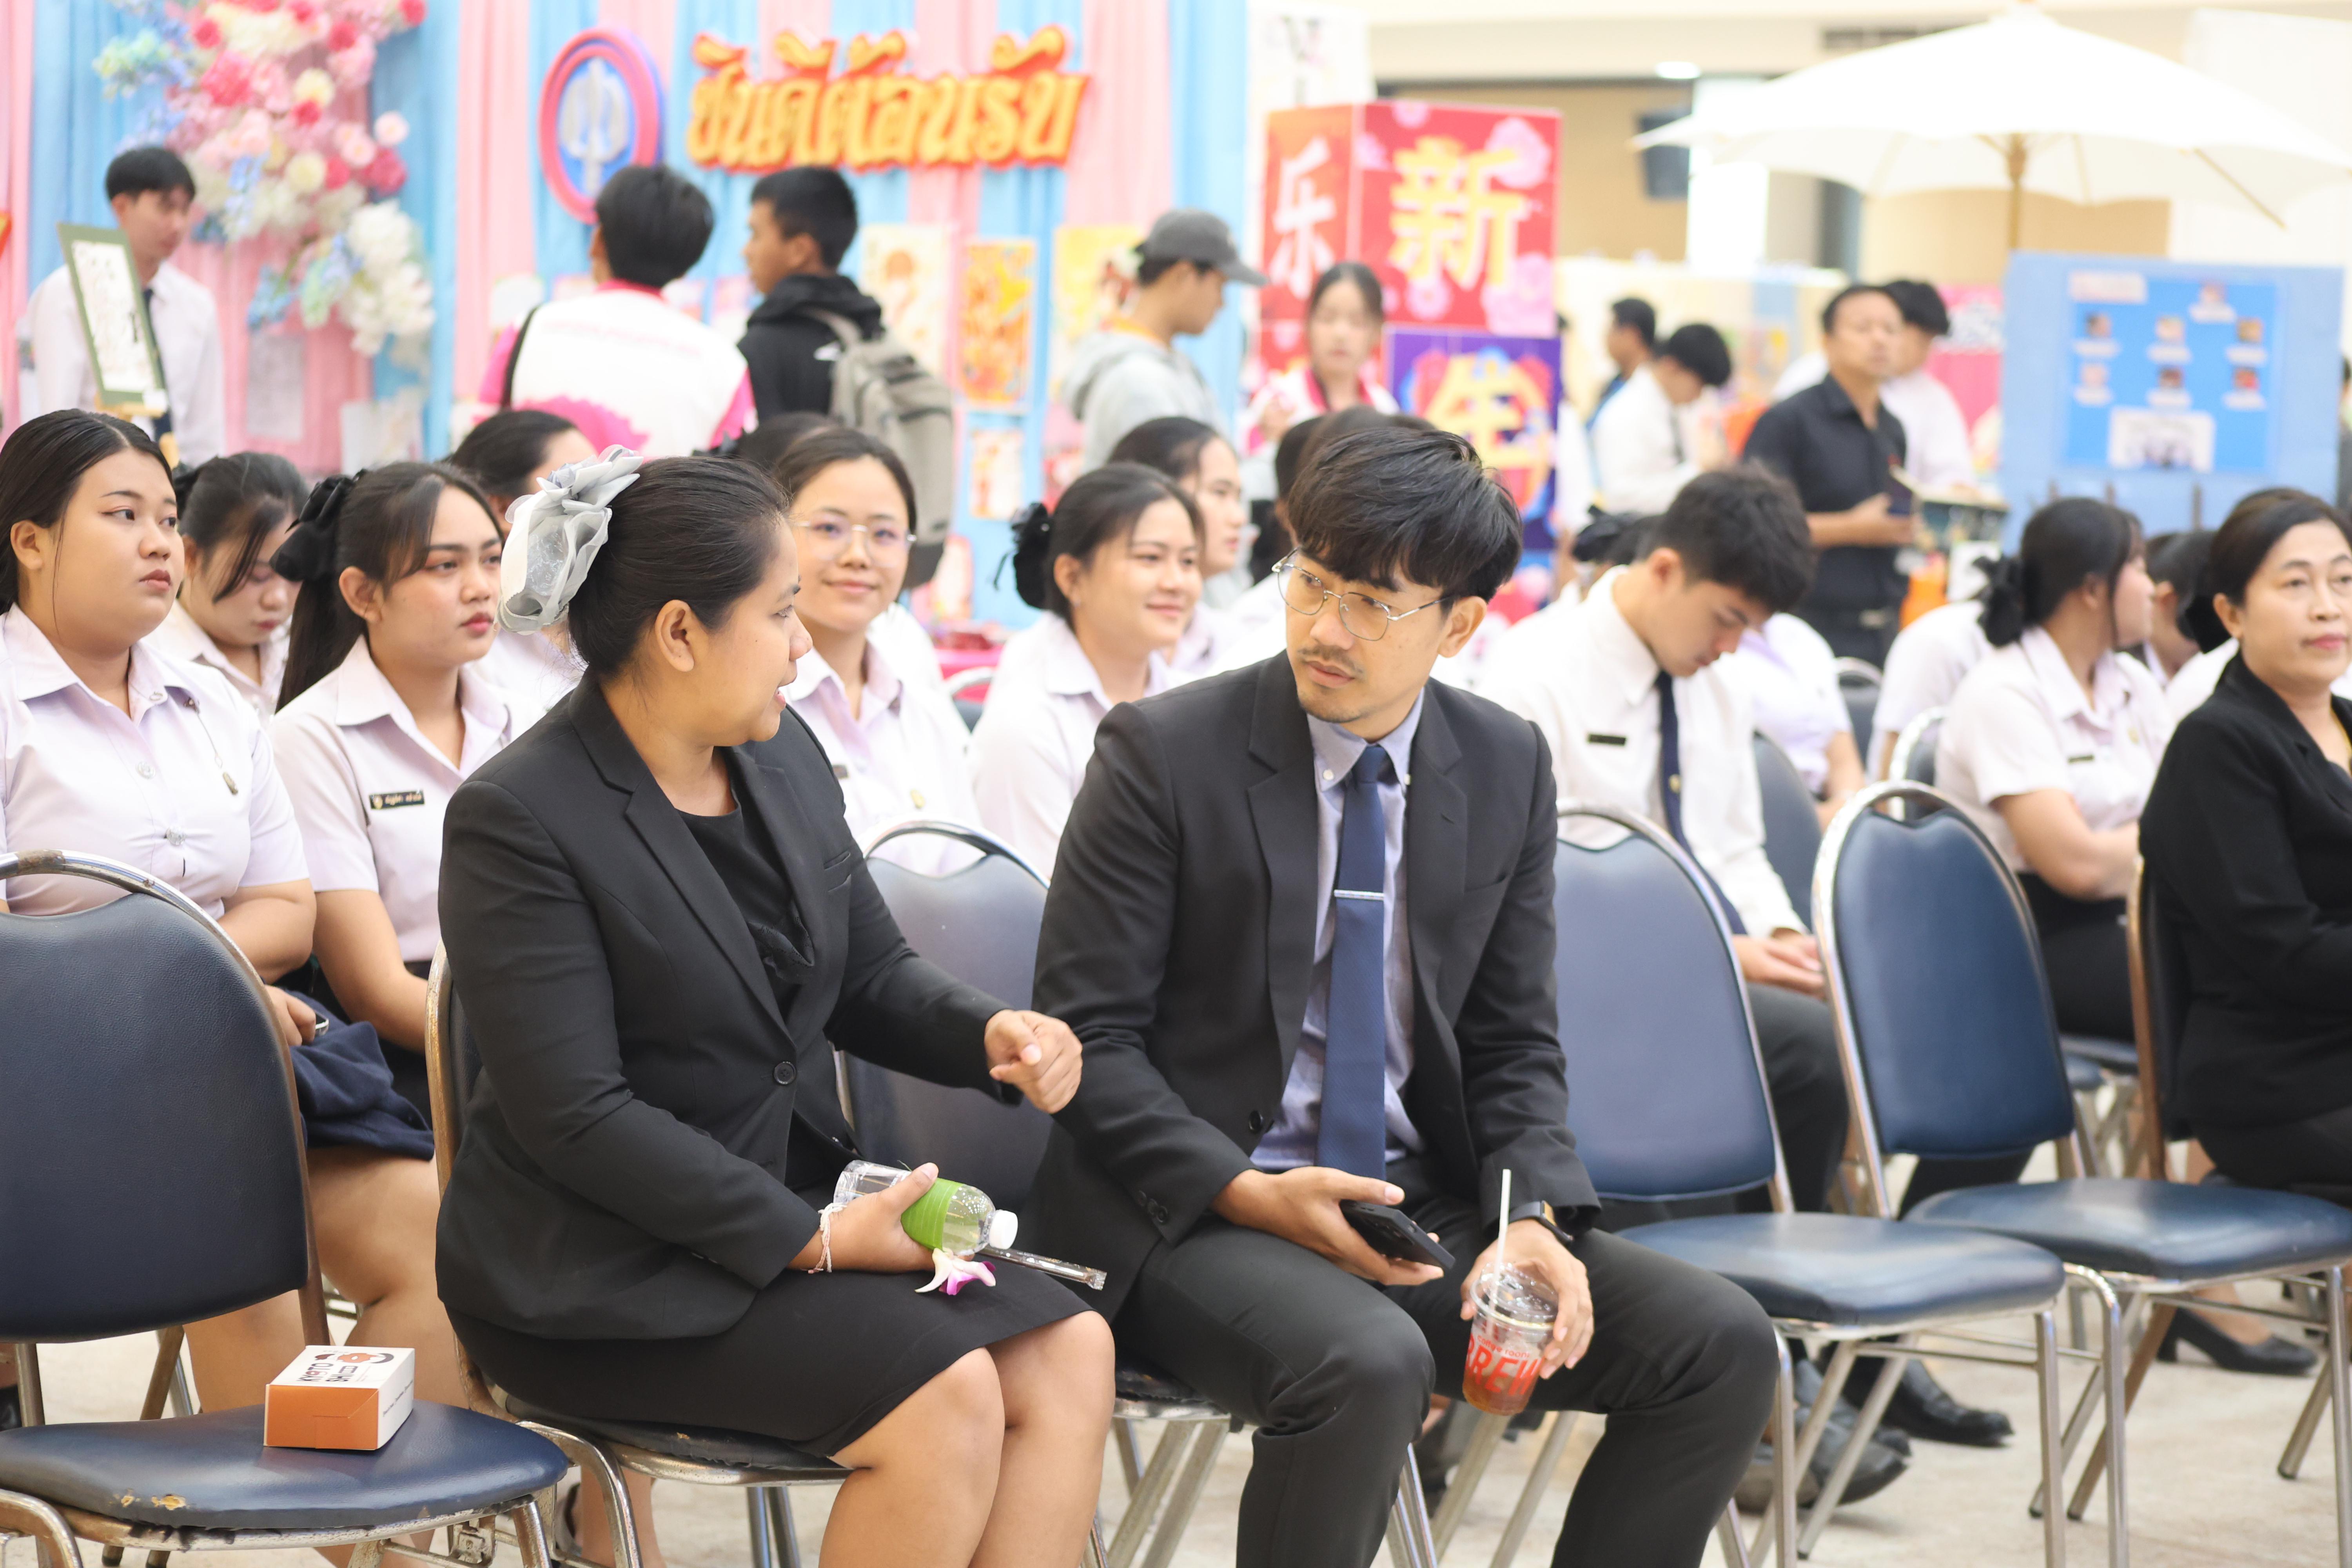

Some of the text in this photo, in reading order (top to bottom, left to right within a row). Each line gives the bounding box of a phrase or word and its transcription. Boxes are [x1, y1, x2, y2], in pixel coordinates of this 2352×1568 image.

[1270, 136, 1336, 298] 乐
[1389, 135, 1529, 289] 新
[1477, 1335, 1503, 1353] coffee
[296, 1362, 334, 1382] KYOTO
[325, 1374, 355, 1382] SHI
